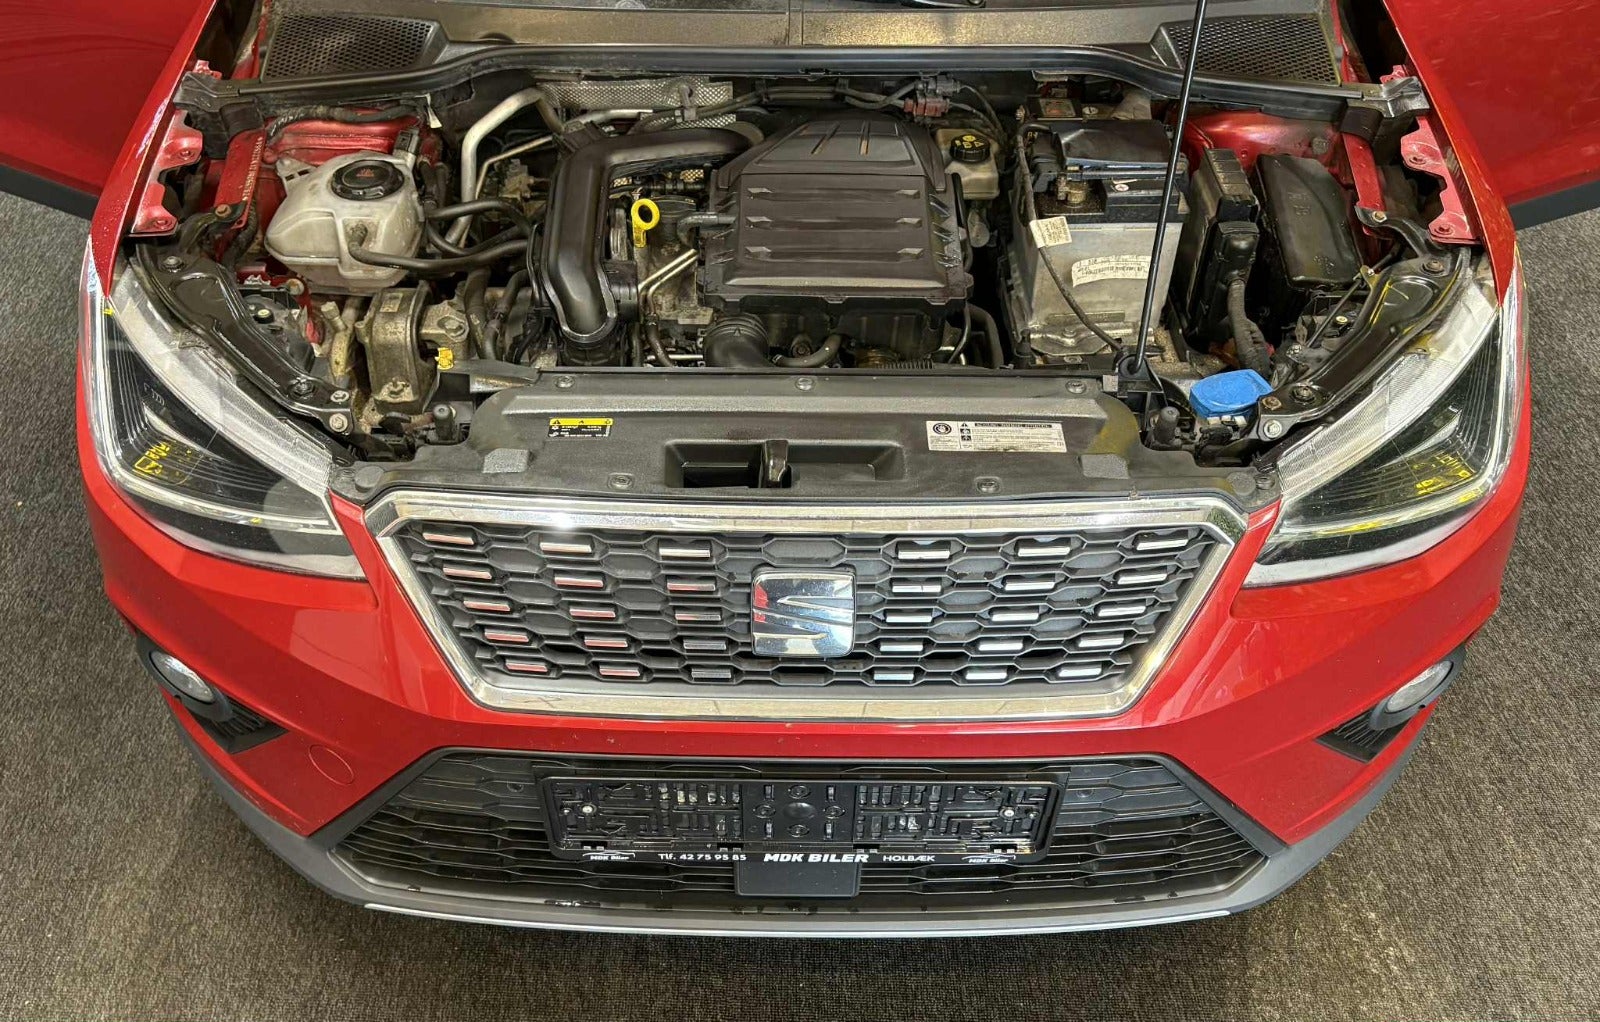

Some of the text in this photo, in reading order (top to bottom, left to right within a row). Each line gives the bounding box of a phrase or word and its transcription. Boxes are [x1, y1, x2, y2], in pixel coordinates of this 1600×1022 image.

[696, 853, 712, 861] 75
[763, 853, 870, 863] MDK BILER
